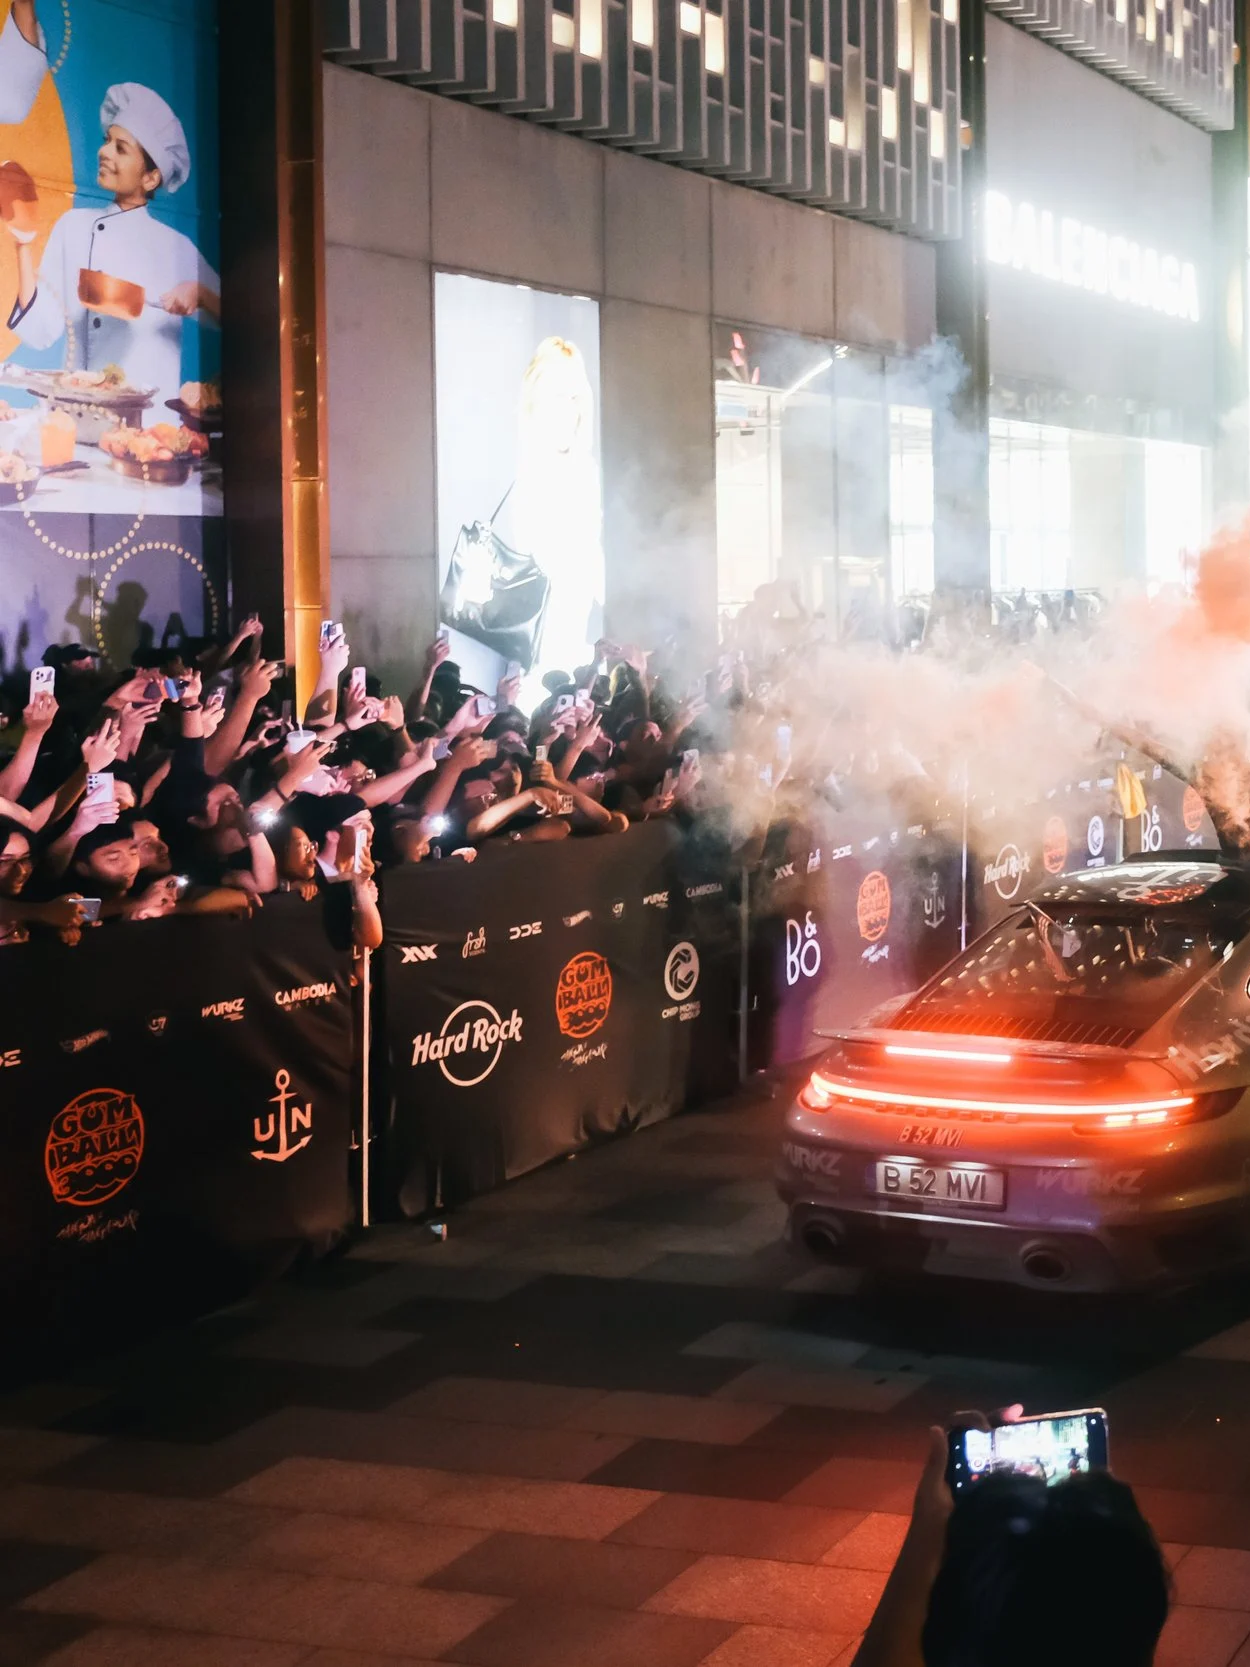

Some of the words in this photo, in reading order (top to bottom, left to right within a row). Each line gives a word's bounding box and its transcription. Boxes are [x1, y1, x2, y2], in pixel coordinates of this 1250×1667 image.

[561, 959, 607, 987] GUM
[201, 998, 245, 1018] WURKZ
[274, 982, 337, 1005] CAMBODIA
[559, 980, 609, 1009] BALL
[412, 1023, 469, 1066] Hard
[472, 1009, 524, 1053] Rock
[53, 1095, 135, 1140] GUM
[50, 1119, 140, 1172] BALL
[899, 1126, 911, 1143] B
[914, 1127, 932, 1144] 52
[934, 1128, 964, 1147] MVI
[884, 1165, 900, 1192] B
[910, 1168, 936, 1194] 52
[947, 1170, 986, 1201] MVI
